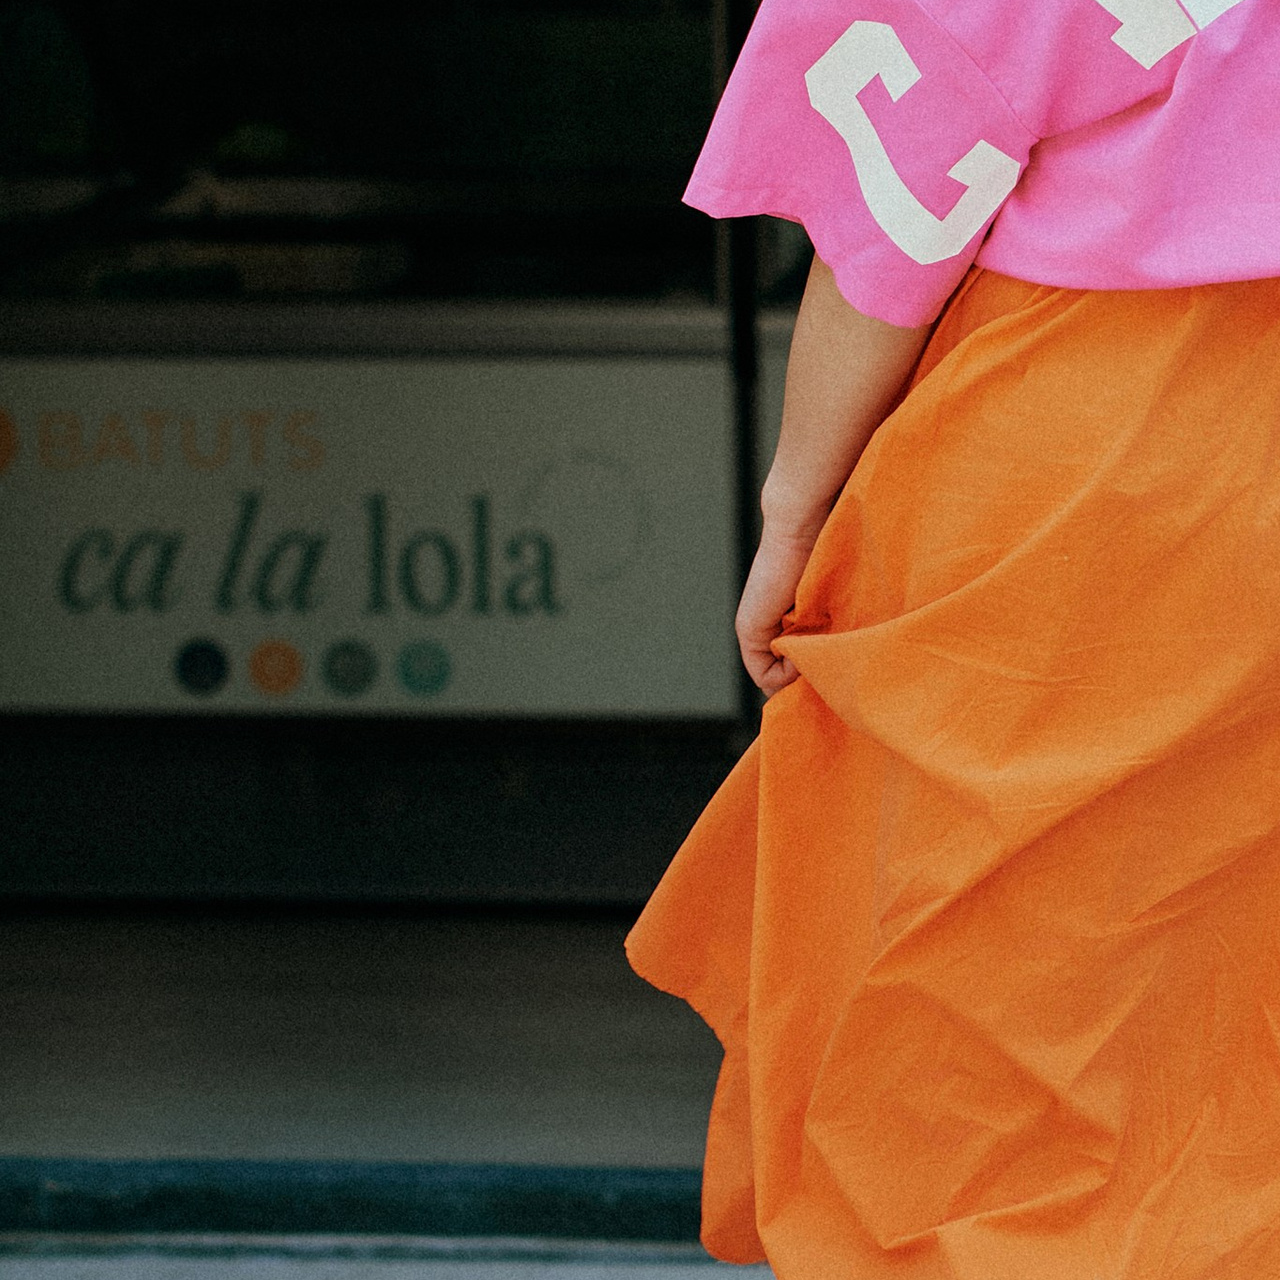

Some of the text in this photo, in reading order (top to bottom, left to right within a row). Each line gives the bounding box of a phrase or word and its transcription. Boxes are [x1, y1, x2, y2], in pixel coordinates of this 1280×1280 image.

[37, 409, 326, 473] BATUTS
[57, 489, 564, 615] ca la lola
